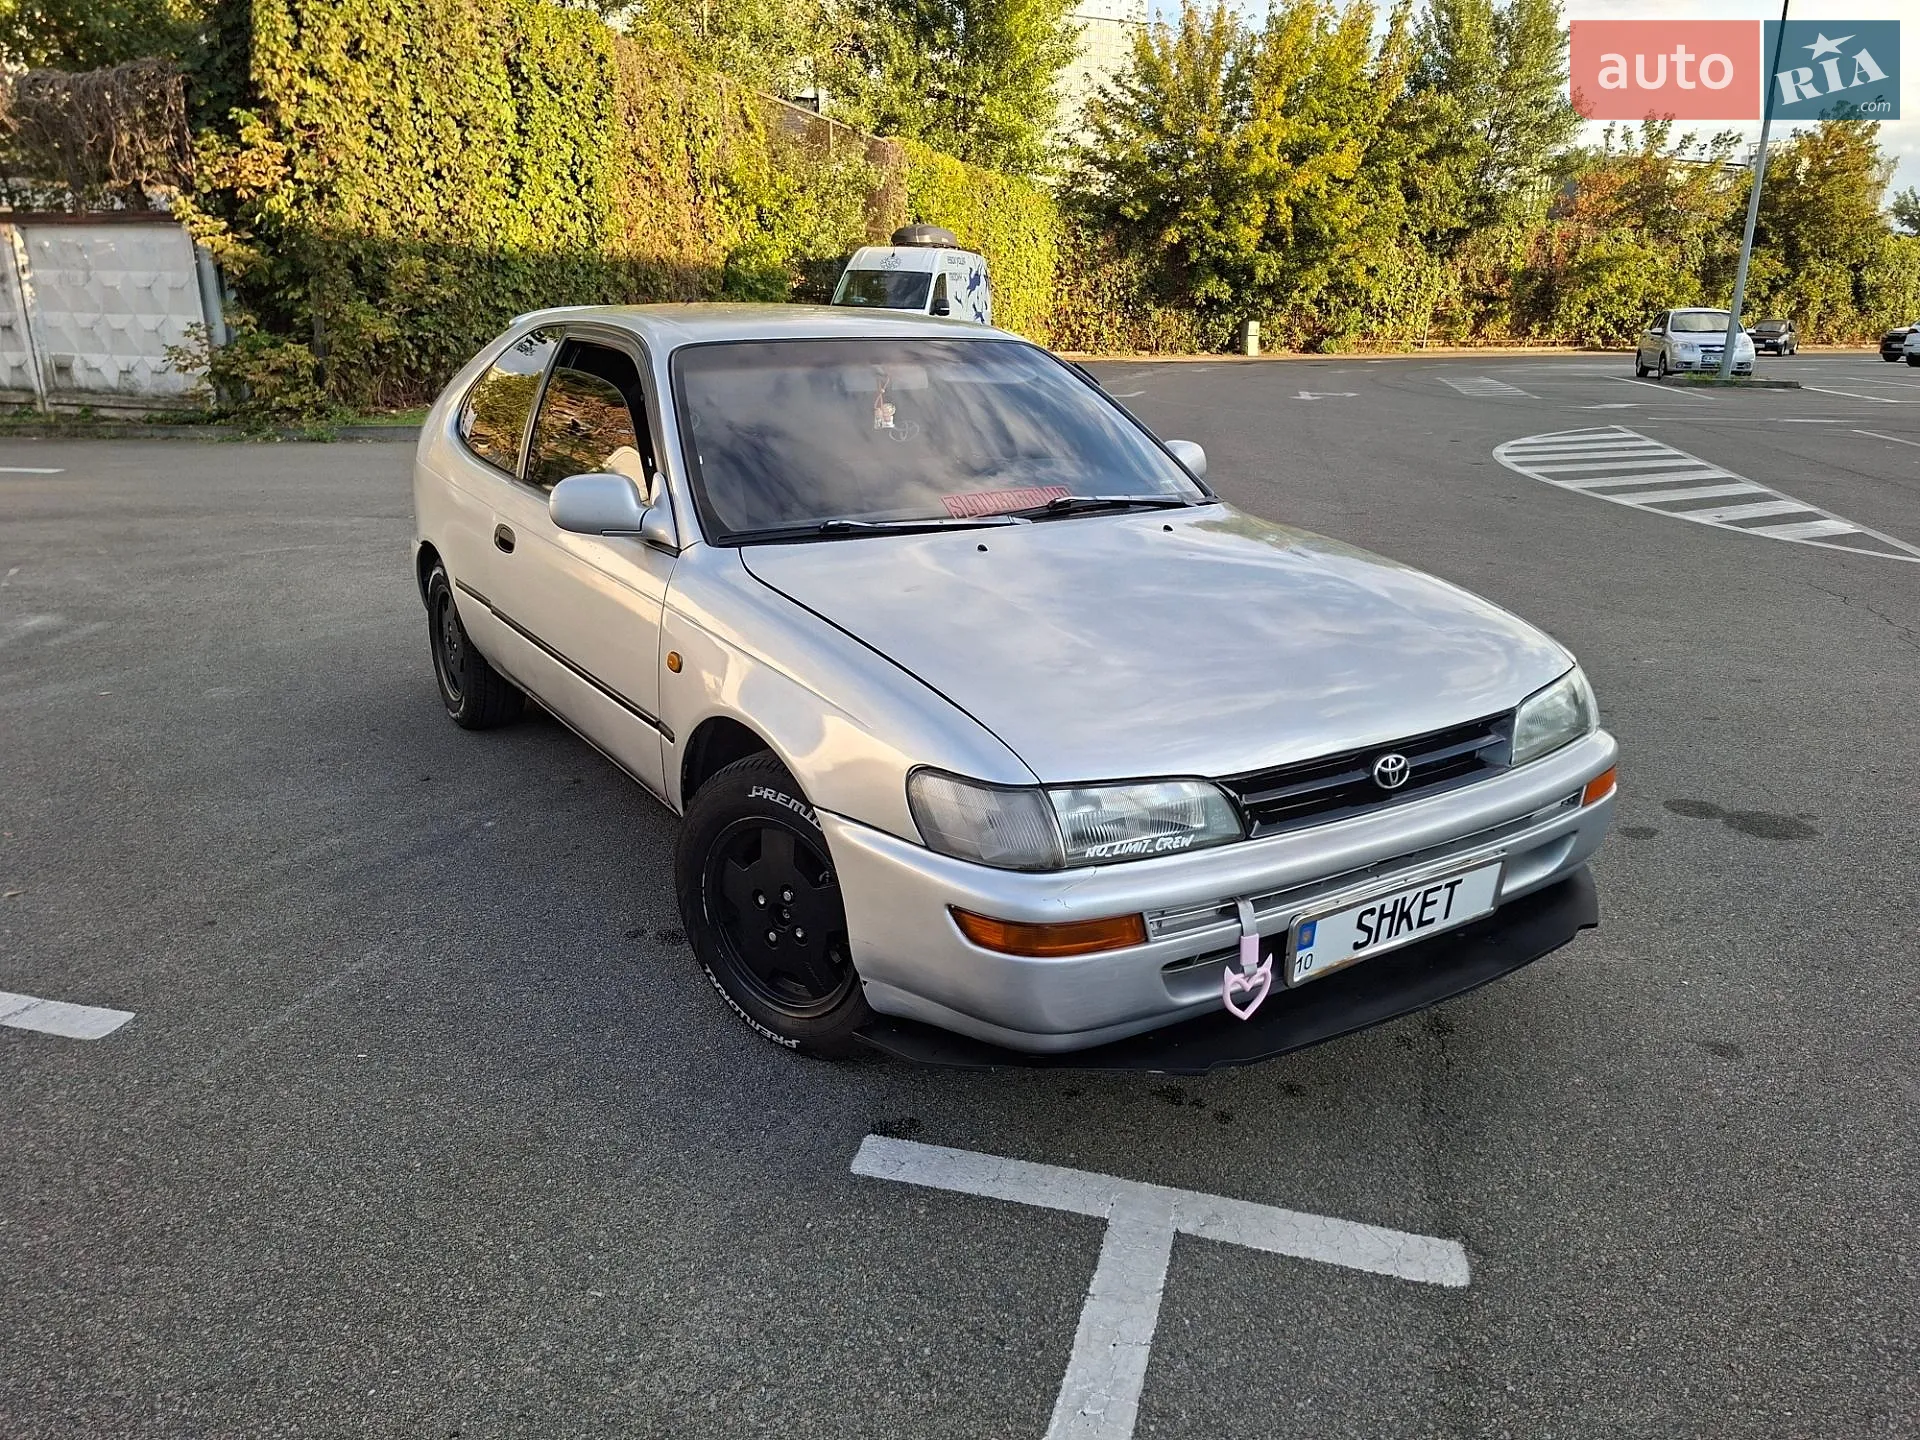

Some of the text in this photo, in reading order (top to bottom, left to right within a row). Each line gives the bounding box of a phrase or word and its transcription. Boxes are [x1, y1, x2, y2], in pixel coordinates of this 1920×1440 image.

[1085, 834, 1195, 858] NO_LIMIT_CREW
[1352, 879, 1463, 951] SHKET
[1295, 953, 1314, 973] 10
